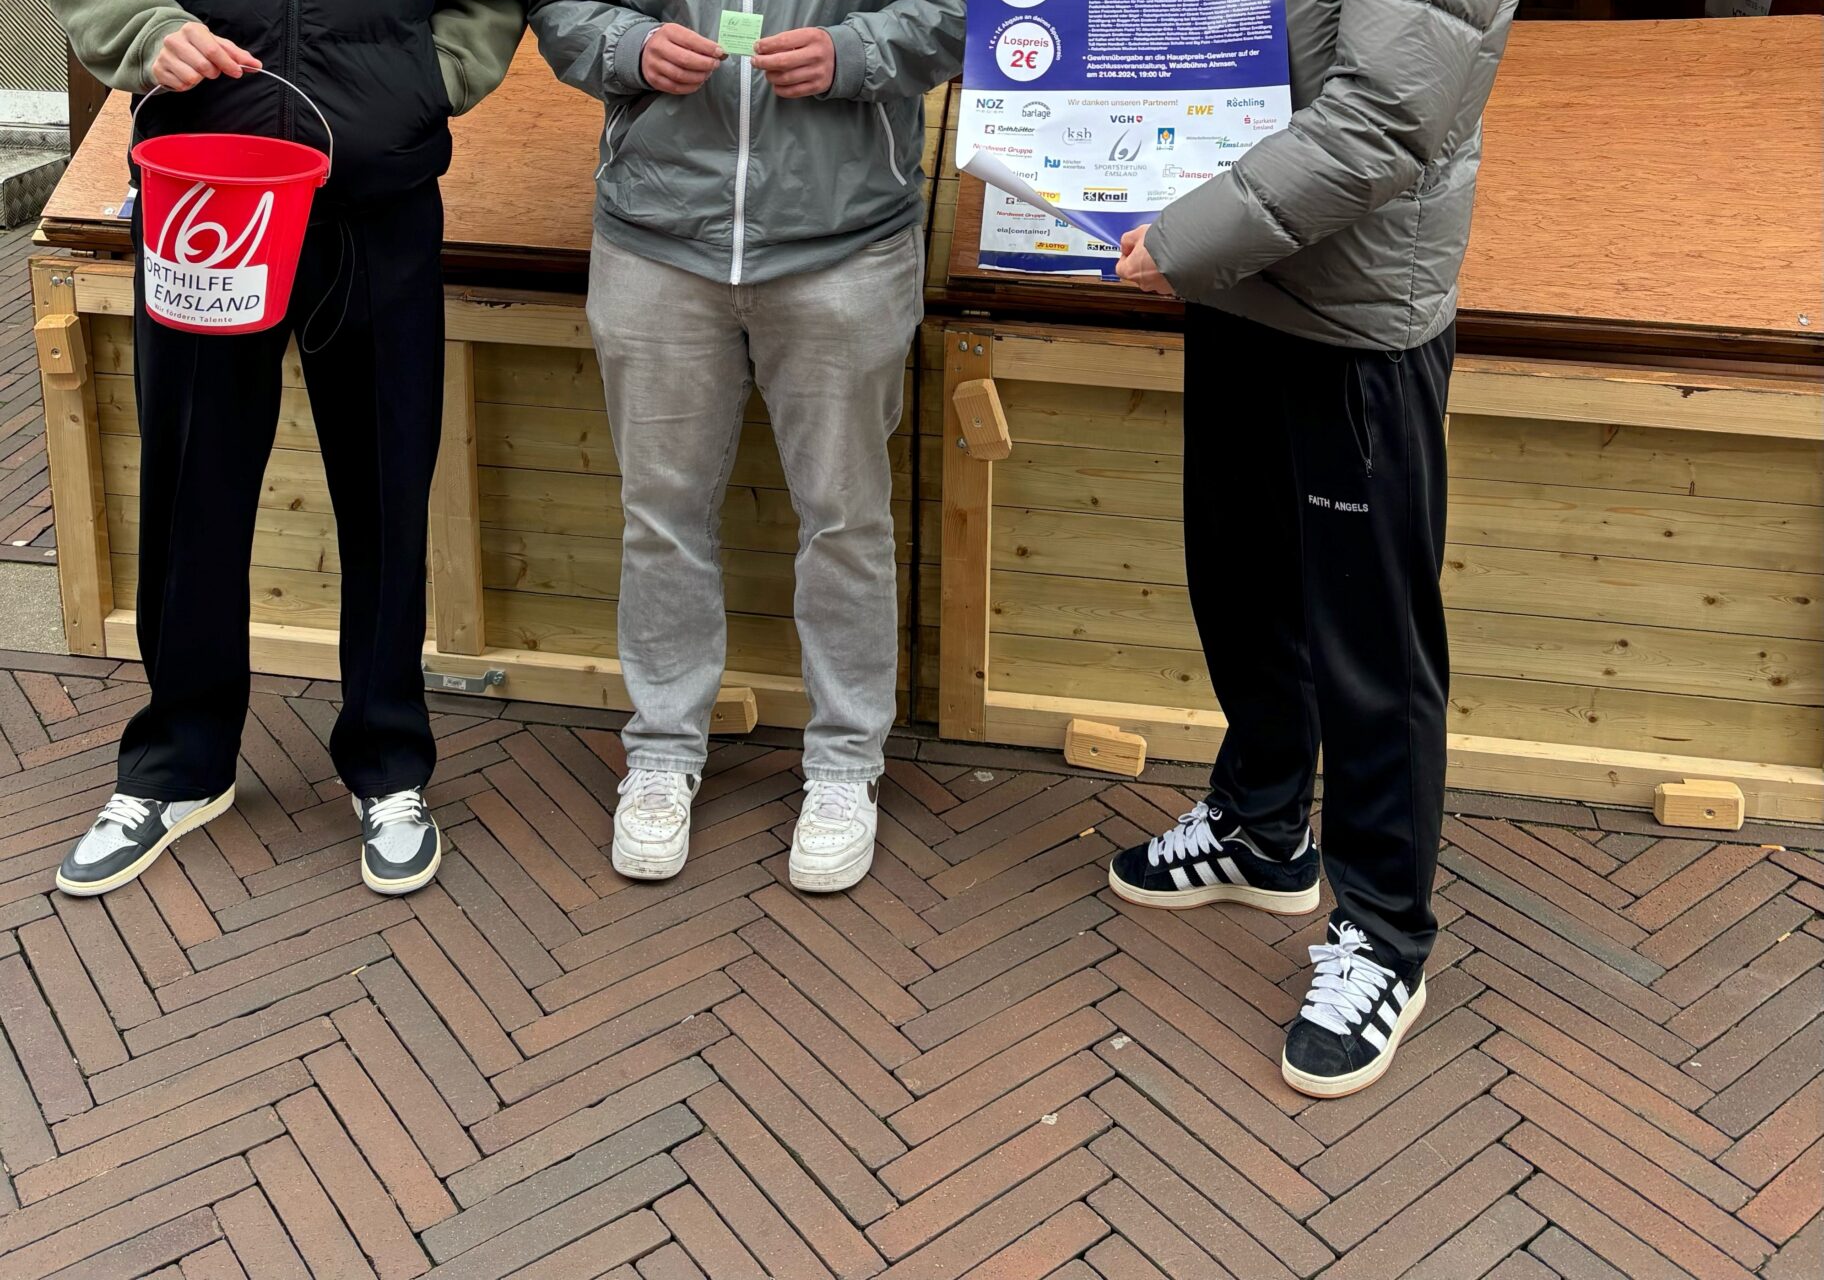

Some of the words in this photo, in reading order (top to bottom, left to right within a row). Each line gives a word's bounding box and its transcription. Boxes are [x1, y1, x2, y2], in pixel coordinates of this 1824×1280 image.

[1004, 35, 1049, 48] Lospreis
[1010, 49, 1039, 69] 2€
[976, 98, 1004, 110] NOZ
[1081, 98, 1110, 106] danken
[1226, 97, 1265, 108] Röchling
[1022, 109, 1051, 120] barlage
[1187, 104, 1214, 116] EWE
[1110, 114, 1135, 124] VGH
[1178, 170, 1214, 179] Jansen
[1097, 191, 1128, 202] Knoll
[144, 255, 234, 292] ORTHILFE
[154, 284, 261, 312] EMSLAND
[166, 307, 197, 322] fördern
[199, 315, 234, 324] Talente
[1308, 494, 1331, 509] FAITH
[1334, 500, 1369, 513] ANGELS
